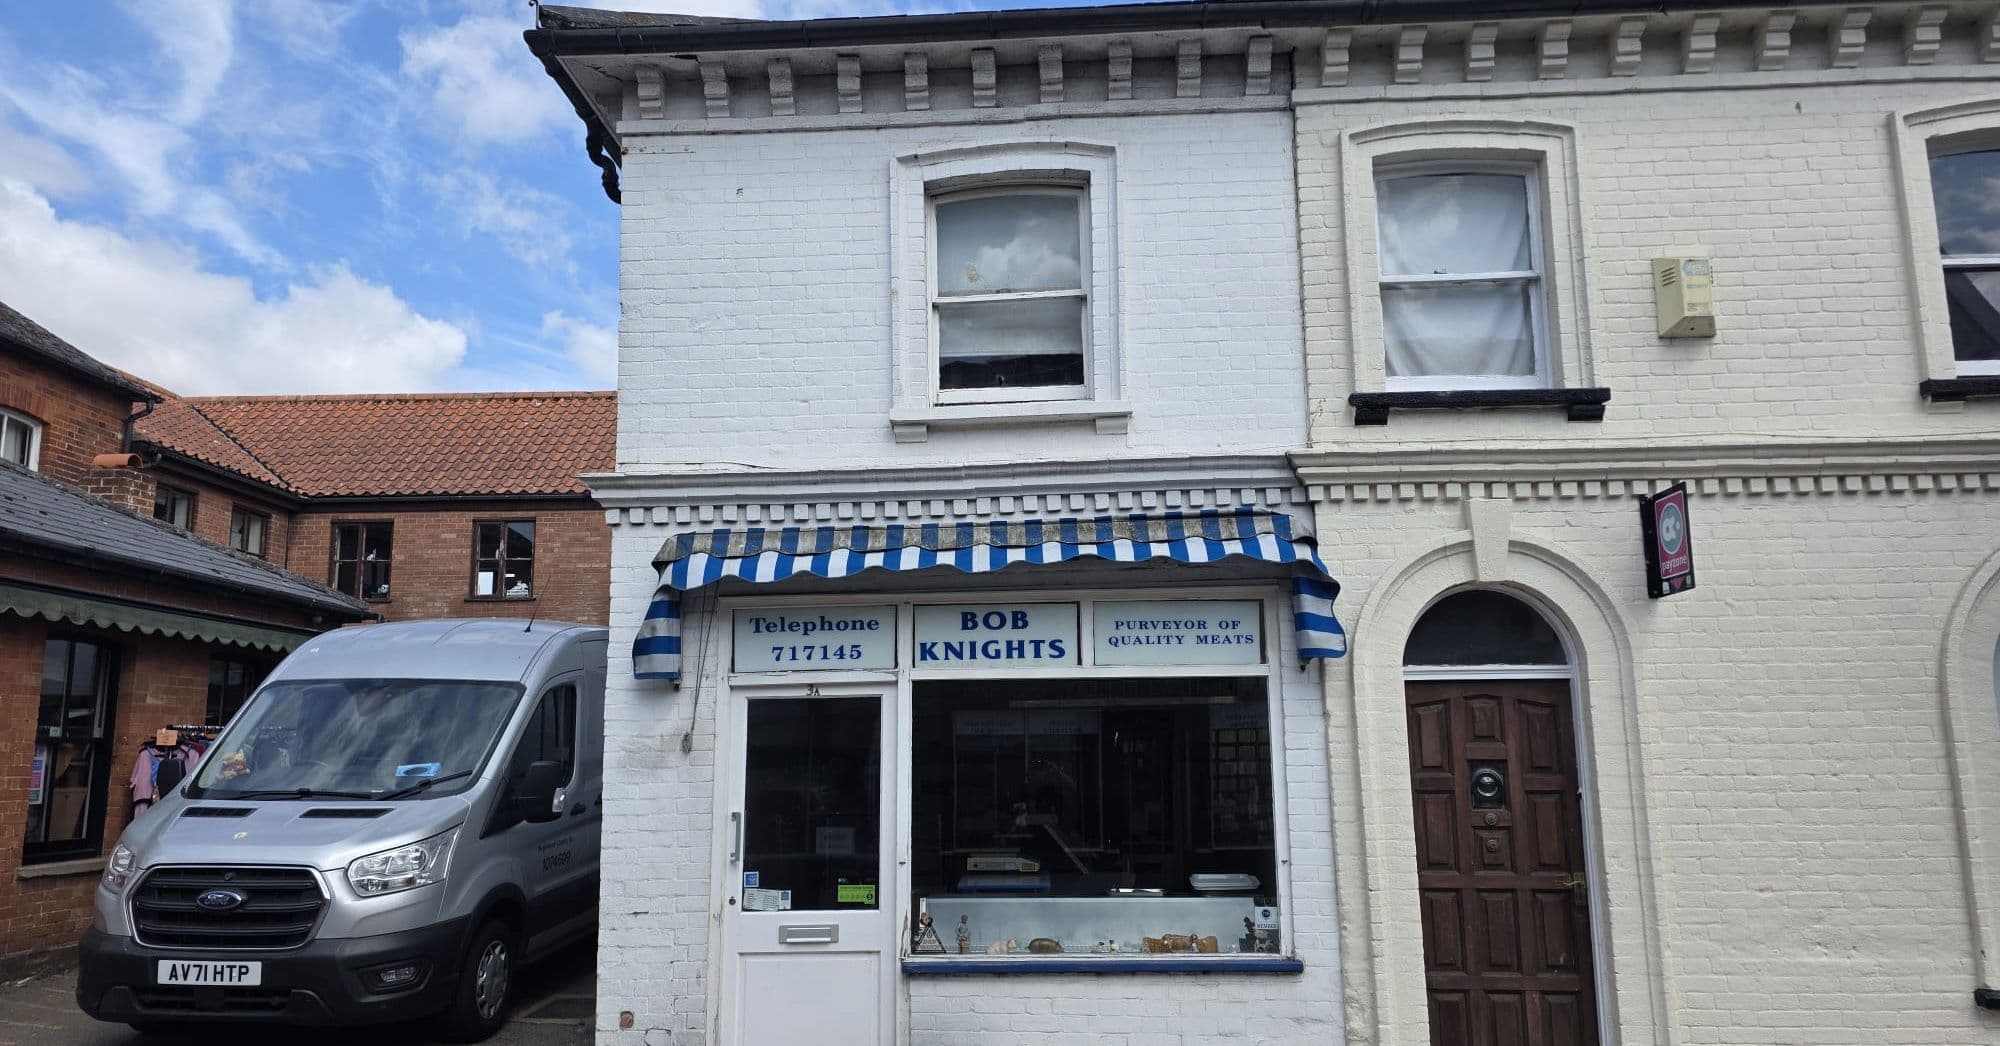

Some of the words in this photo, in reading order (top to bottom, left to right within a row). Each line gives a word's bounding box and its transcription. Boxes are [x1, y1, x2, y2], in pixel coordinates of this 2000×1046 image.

[749, 616, 880, 636] Telephone
[960, 611, 1029, 631] BOB
[1114, 620, 1207, 631] PURVEYOR
[1218, 620, 1241, 630] OF
[1108, 635, 1185, 647] QUALITY
[1196, 634, 1255, 645] MEATS
[770, 643, 863, 662] 717145
[919, 639, 1066, 662] KNIGHTS
[806, 683, 821, 697] 3A
[168, 963, 208, 982] AV71
[213, 964, 250, 983] HTP
